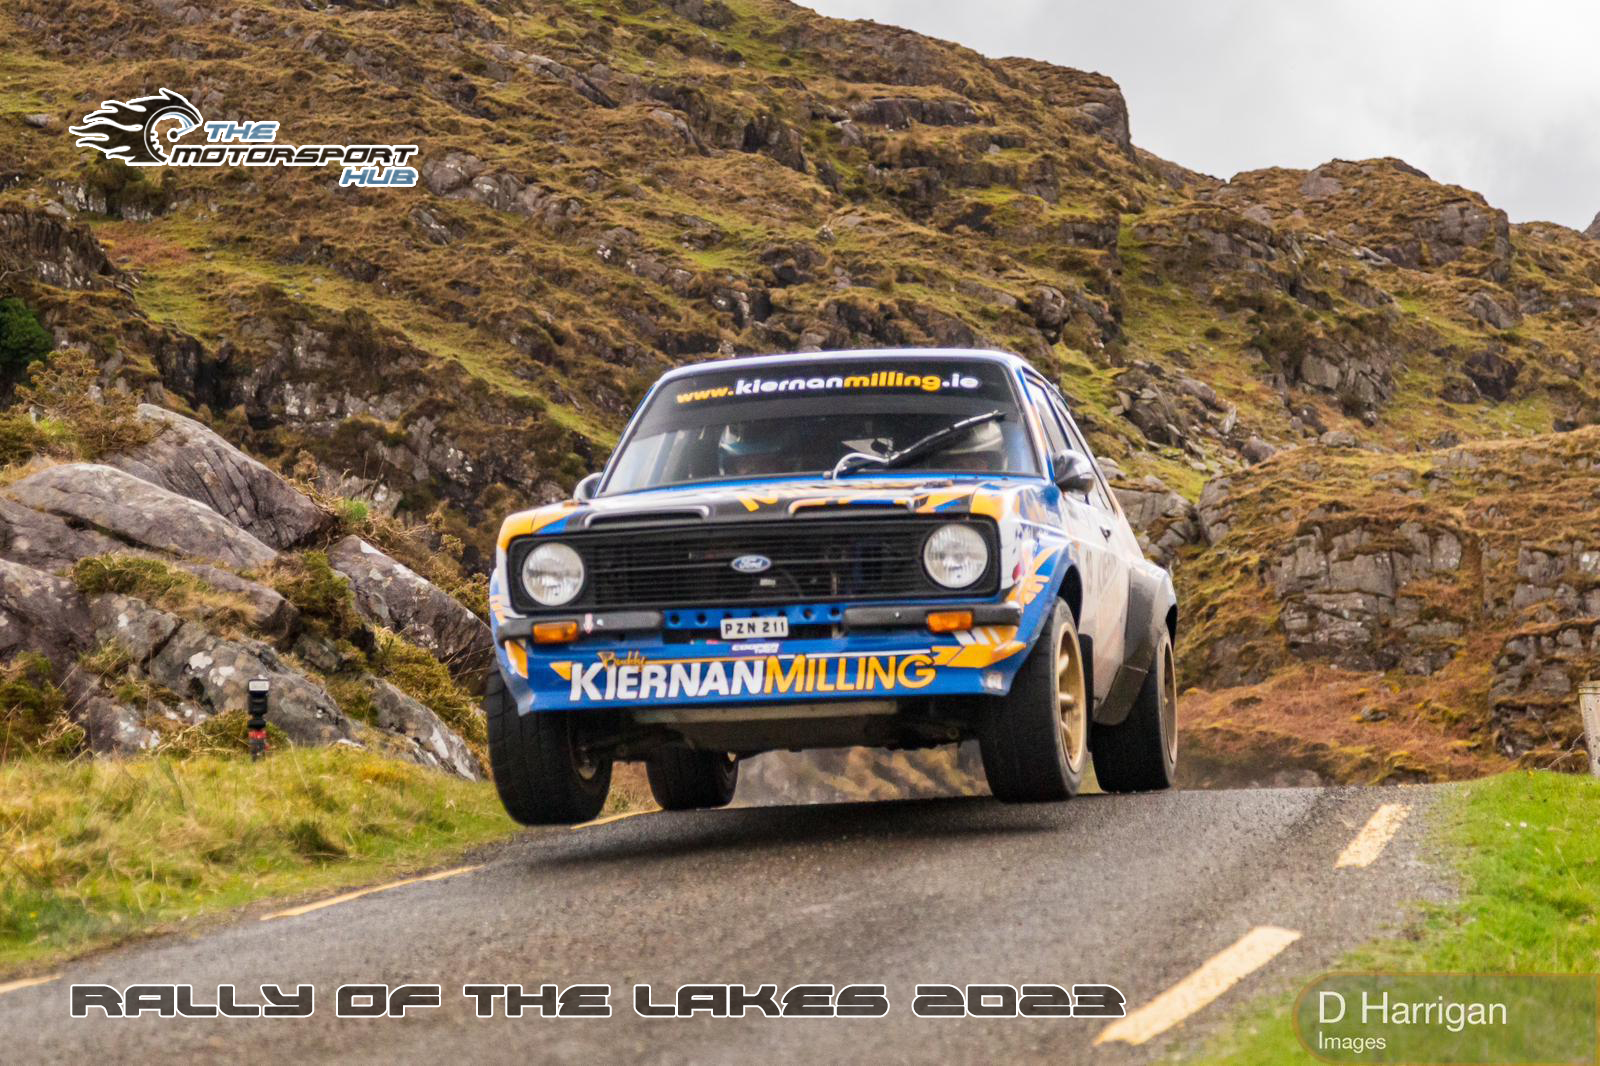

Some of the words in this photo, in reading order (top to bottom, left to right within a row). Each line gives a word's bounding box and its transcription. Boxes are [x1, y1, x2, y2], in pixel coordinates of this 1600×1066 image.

[676, 371, 980, 404] www.kiernanmilling.ie
[725, 622, 756, 635] PZN
[762, 621, 785, 633] 211
